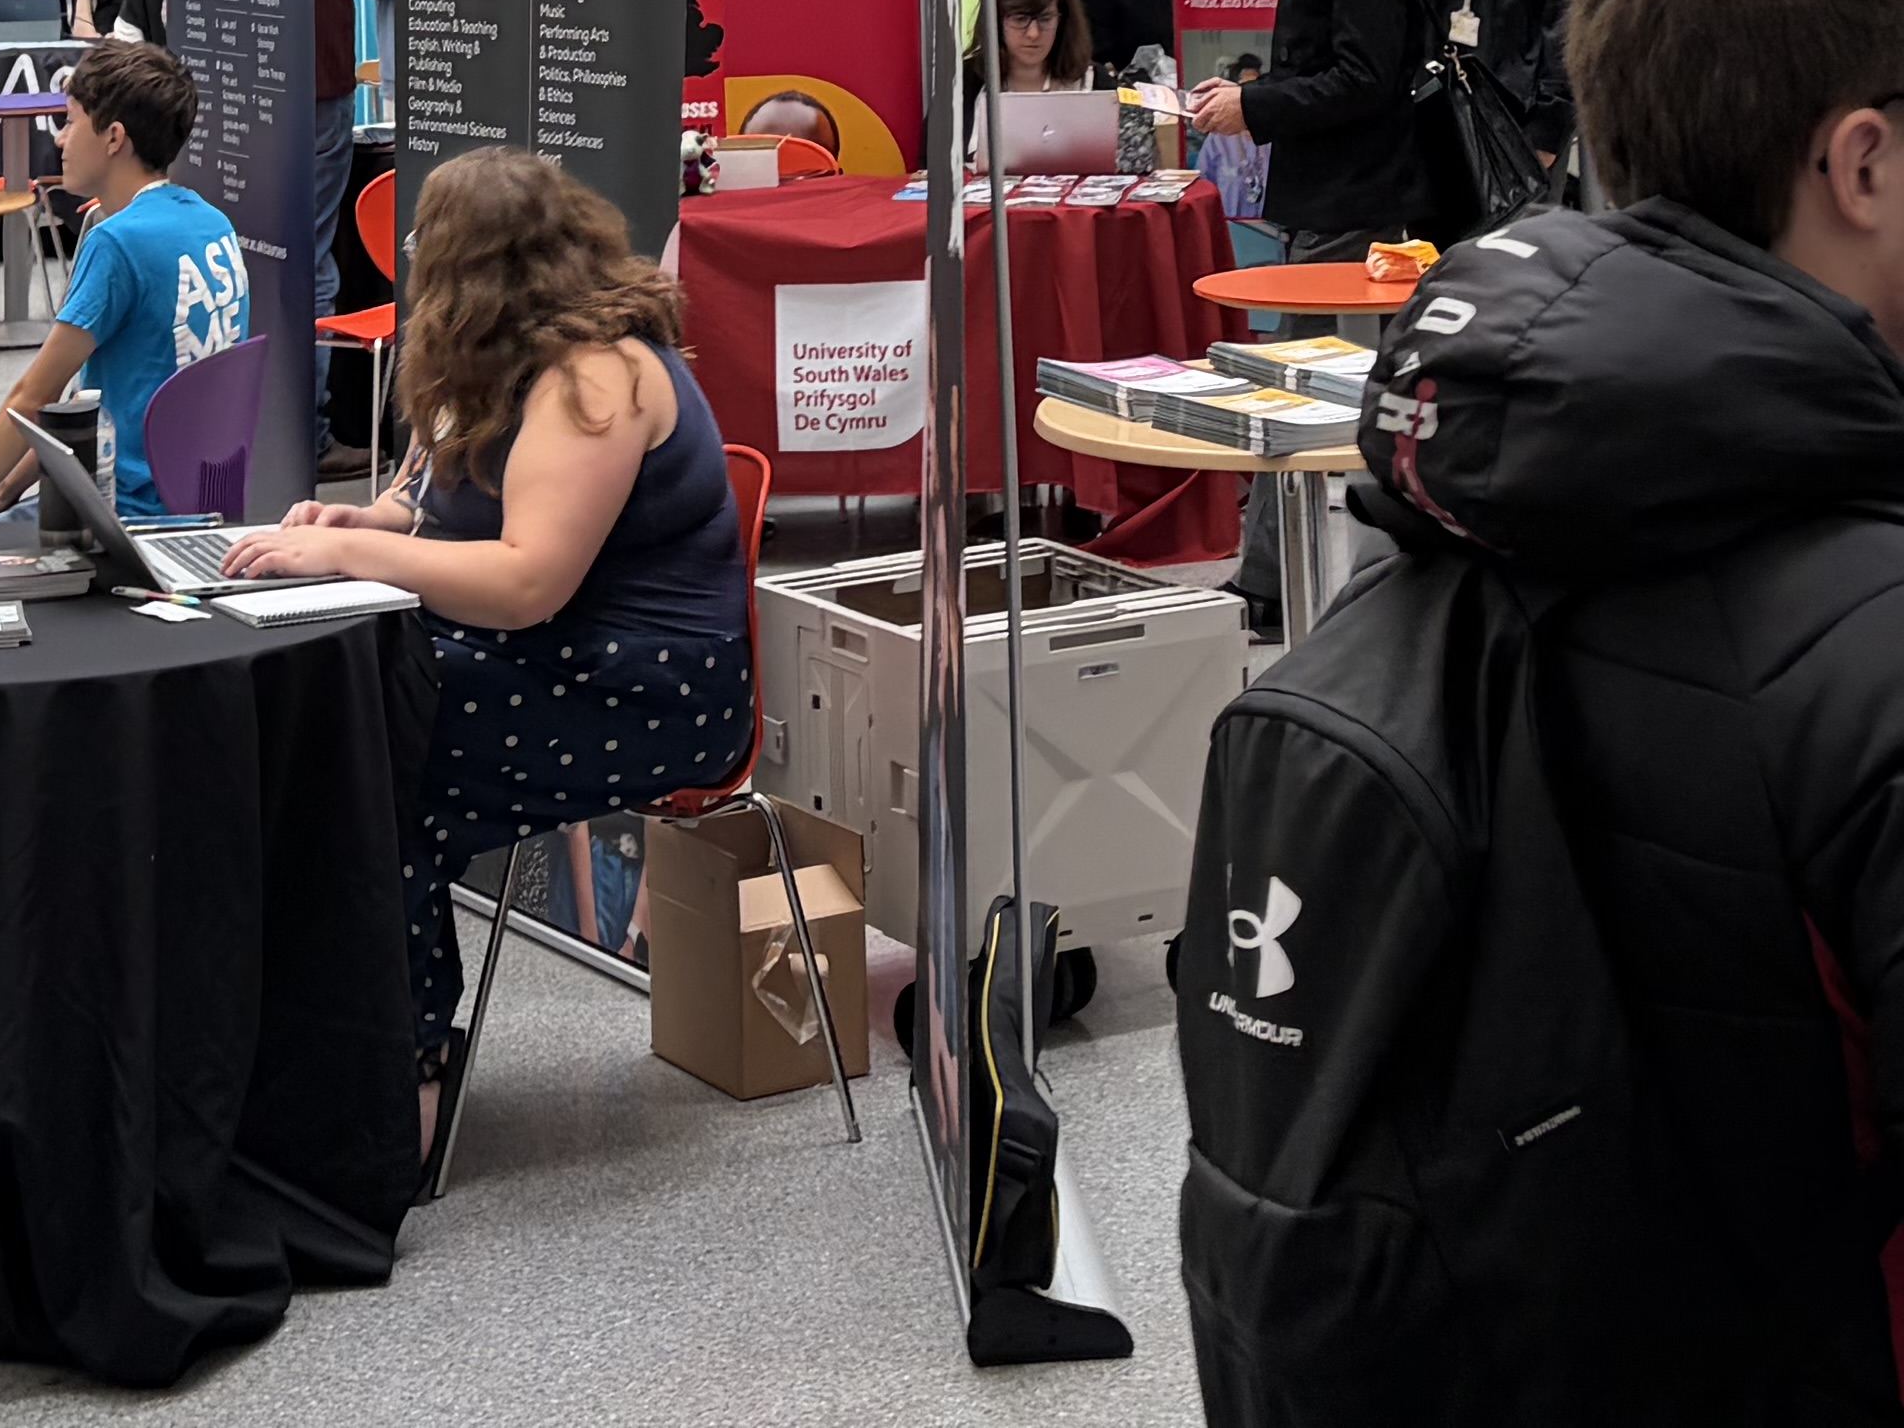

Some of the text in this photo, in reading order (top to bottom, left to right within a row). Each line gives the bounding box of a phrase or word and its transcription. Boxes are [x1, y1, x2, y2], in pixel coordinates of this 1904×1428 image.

[539, 4, 566, 18] Music
[408, 17, 451, 32] Education
[460, 19, 498, 40] Teaching
[539, 24, 610, 46] Performing Arts
[442, 40, 473, 59] Writing
[547, 45, 596, 62] Production
[408, 56, 452, 77] Publishing
[408, 76, 462, 93] Film Media
[547, 87, 573, 104] Ethics
[408, 96, 454, 117] Geography
[538, 107, 576, 126] Sciences
[408, 116, 507, 139] Environmental Sciences
[408, 137, 439, 156] History
[793, 339, 912, 362] University of
[793, 364, 909, 384] South Wales
[793, 388, 876, 411] Prifysgol
[795, 413, 887, 434] De Cymru
